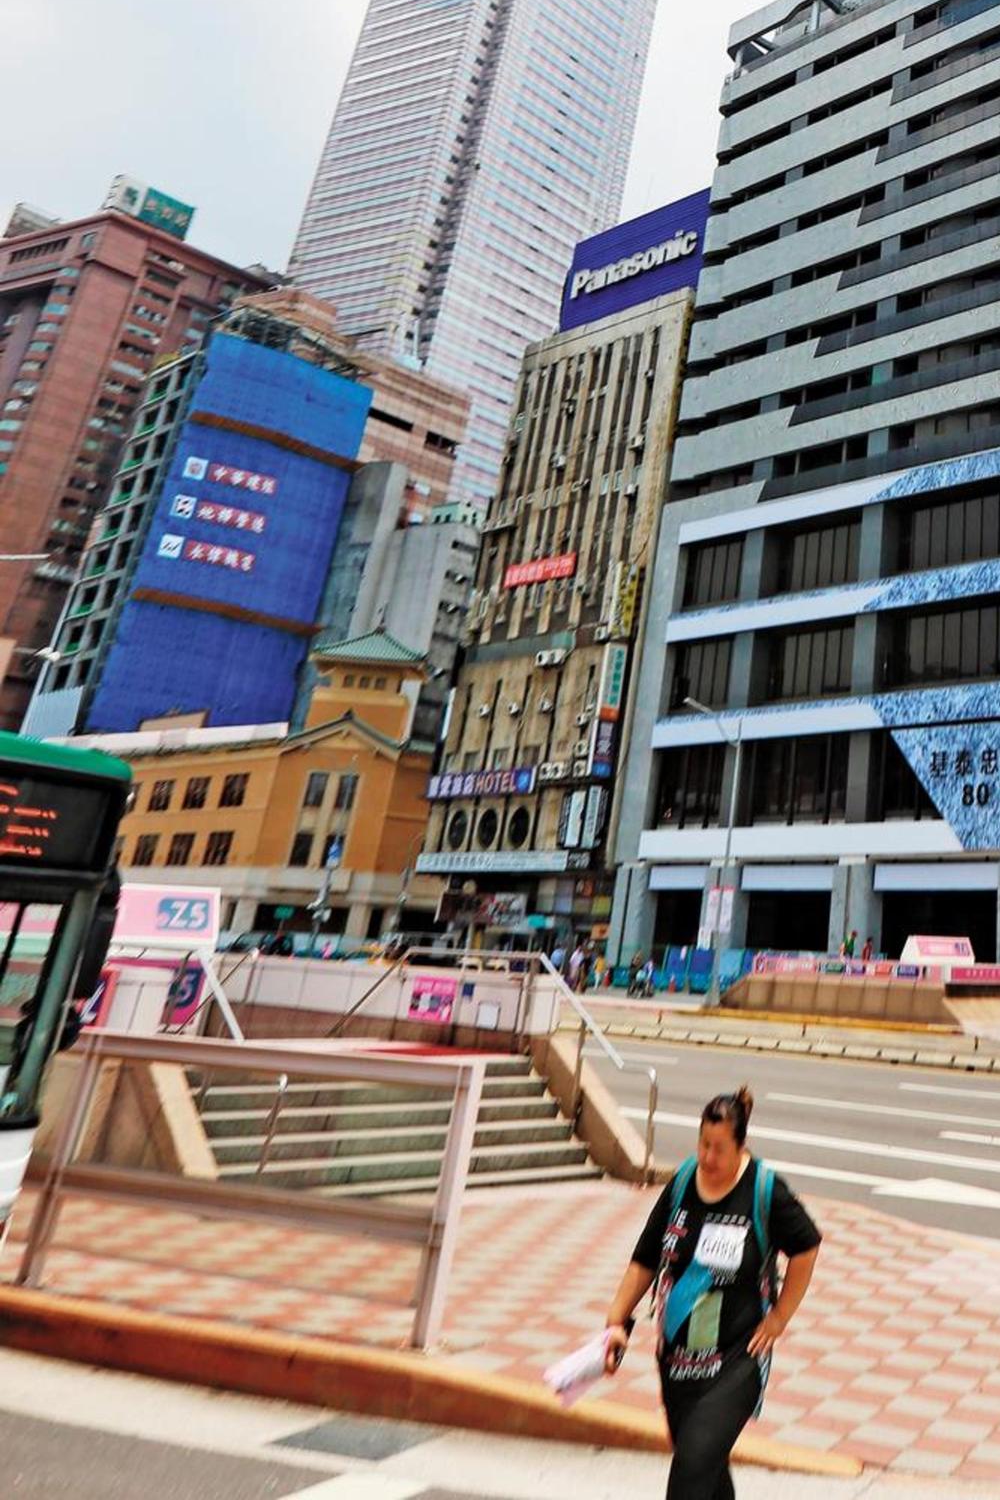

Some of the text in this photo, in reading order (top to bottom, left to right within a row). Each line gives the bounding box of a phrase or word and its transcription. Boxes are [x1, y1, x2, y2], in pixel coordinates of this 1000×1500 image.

[570, 230, 698, 300] Panasonic
[475, 770, 517, 790] HOTEL
[962, 783, 990, 807] 80
